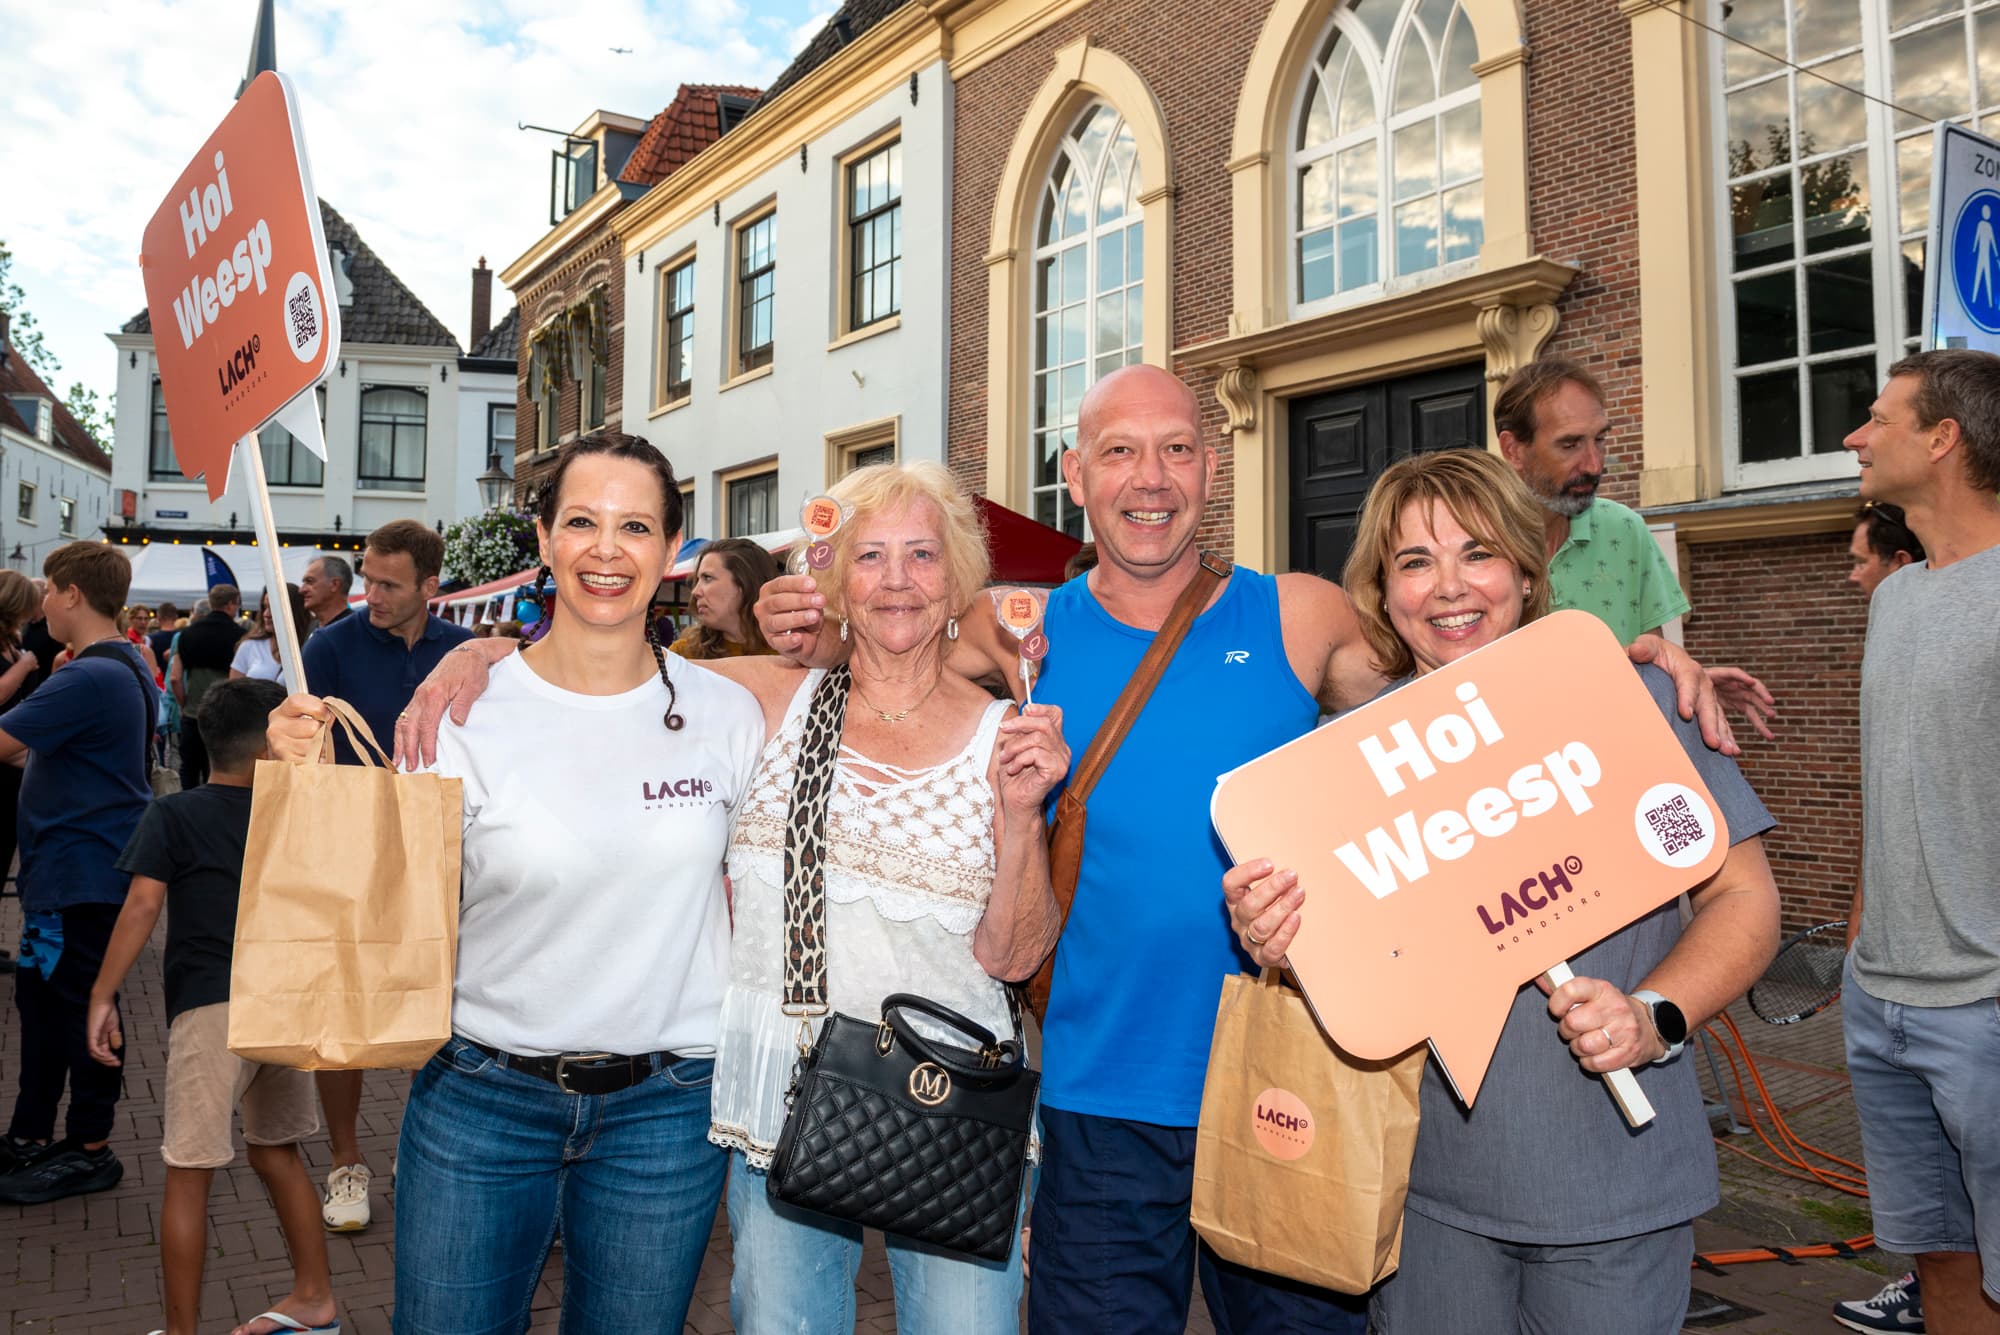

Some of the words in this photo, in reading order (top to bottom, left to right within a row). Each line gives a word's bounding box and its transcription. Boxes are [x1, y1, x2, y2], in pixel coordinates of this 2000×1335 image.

[179, 150, 233, 260] Hoi
[173, 218, 272, 350] Weesp
[1357, 681, 1505, 798] Hoi
[1332, 741, 1602, 900] Weesp
[1497, 890, 1601, 953] MONDZORG
